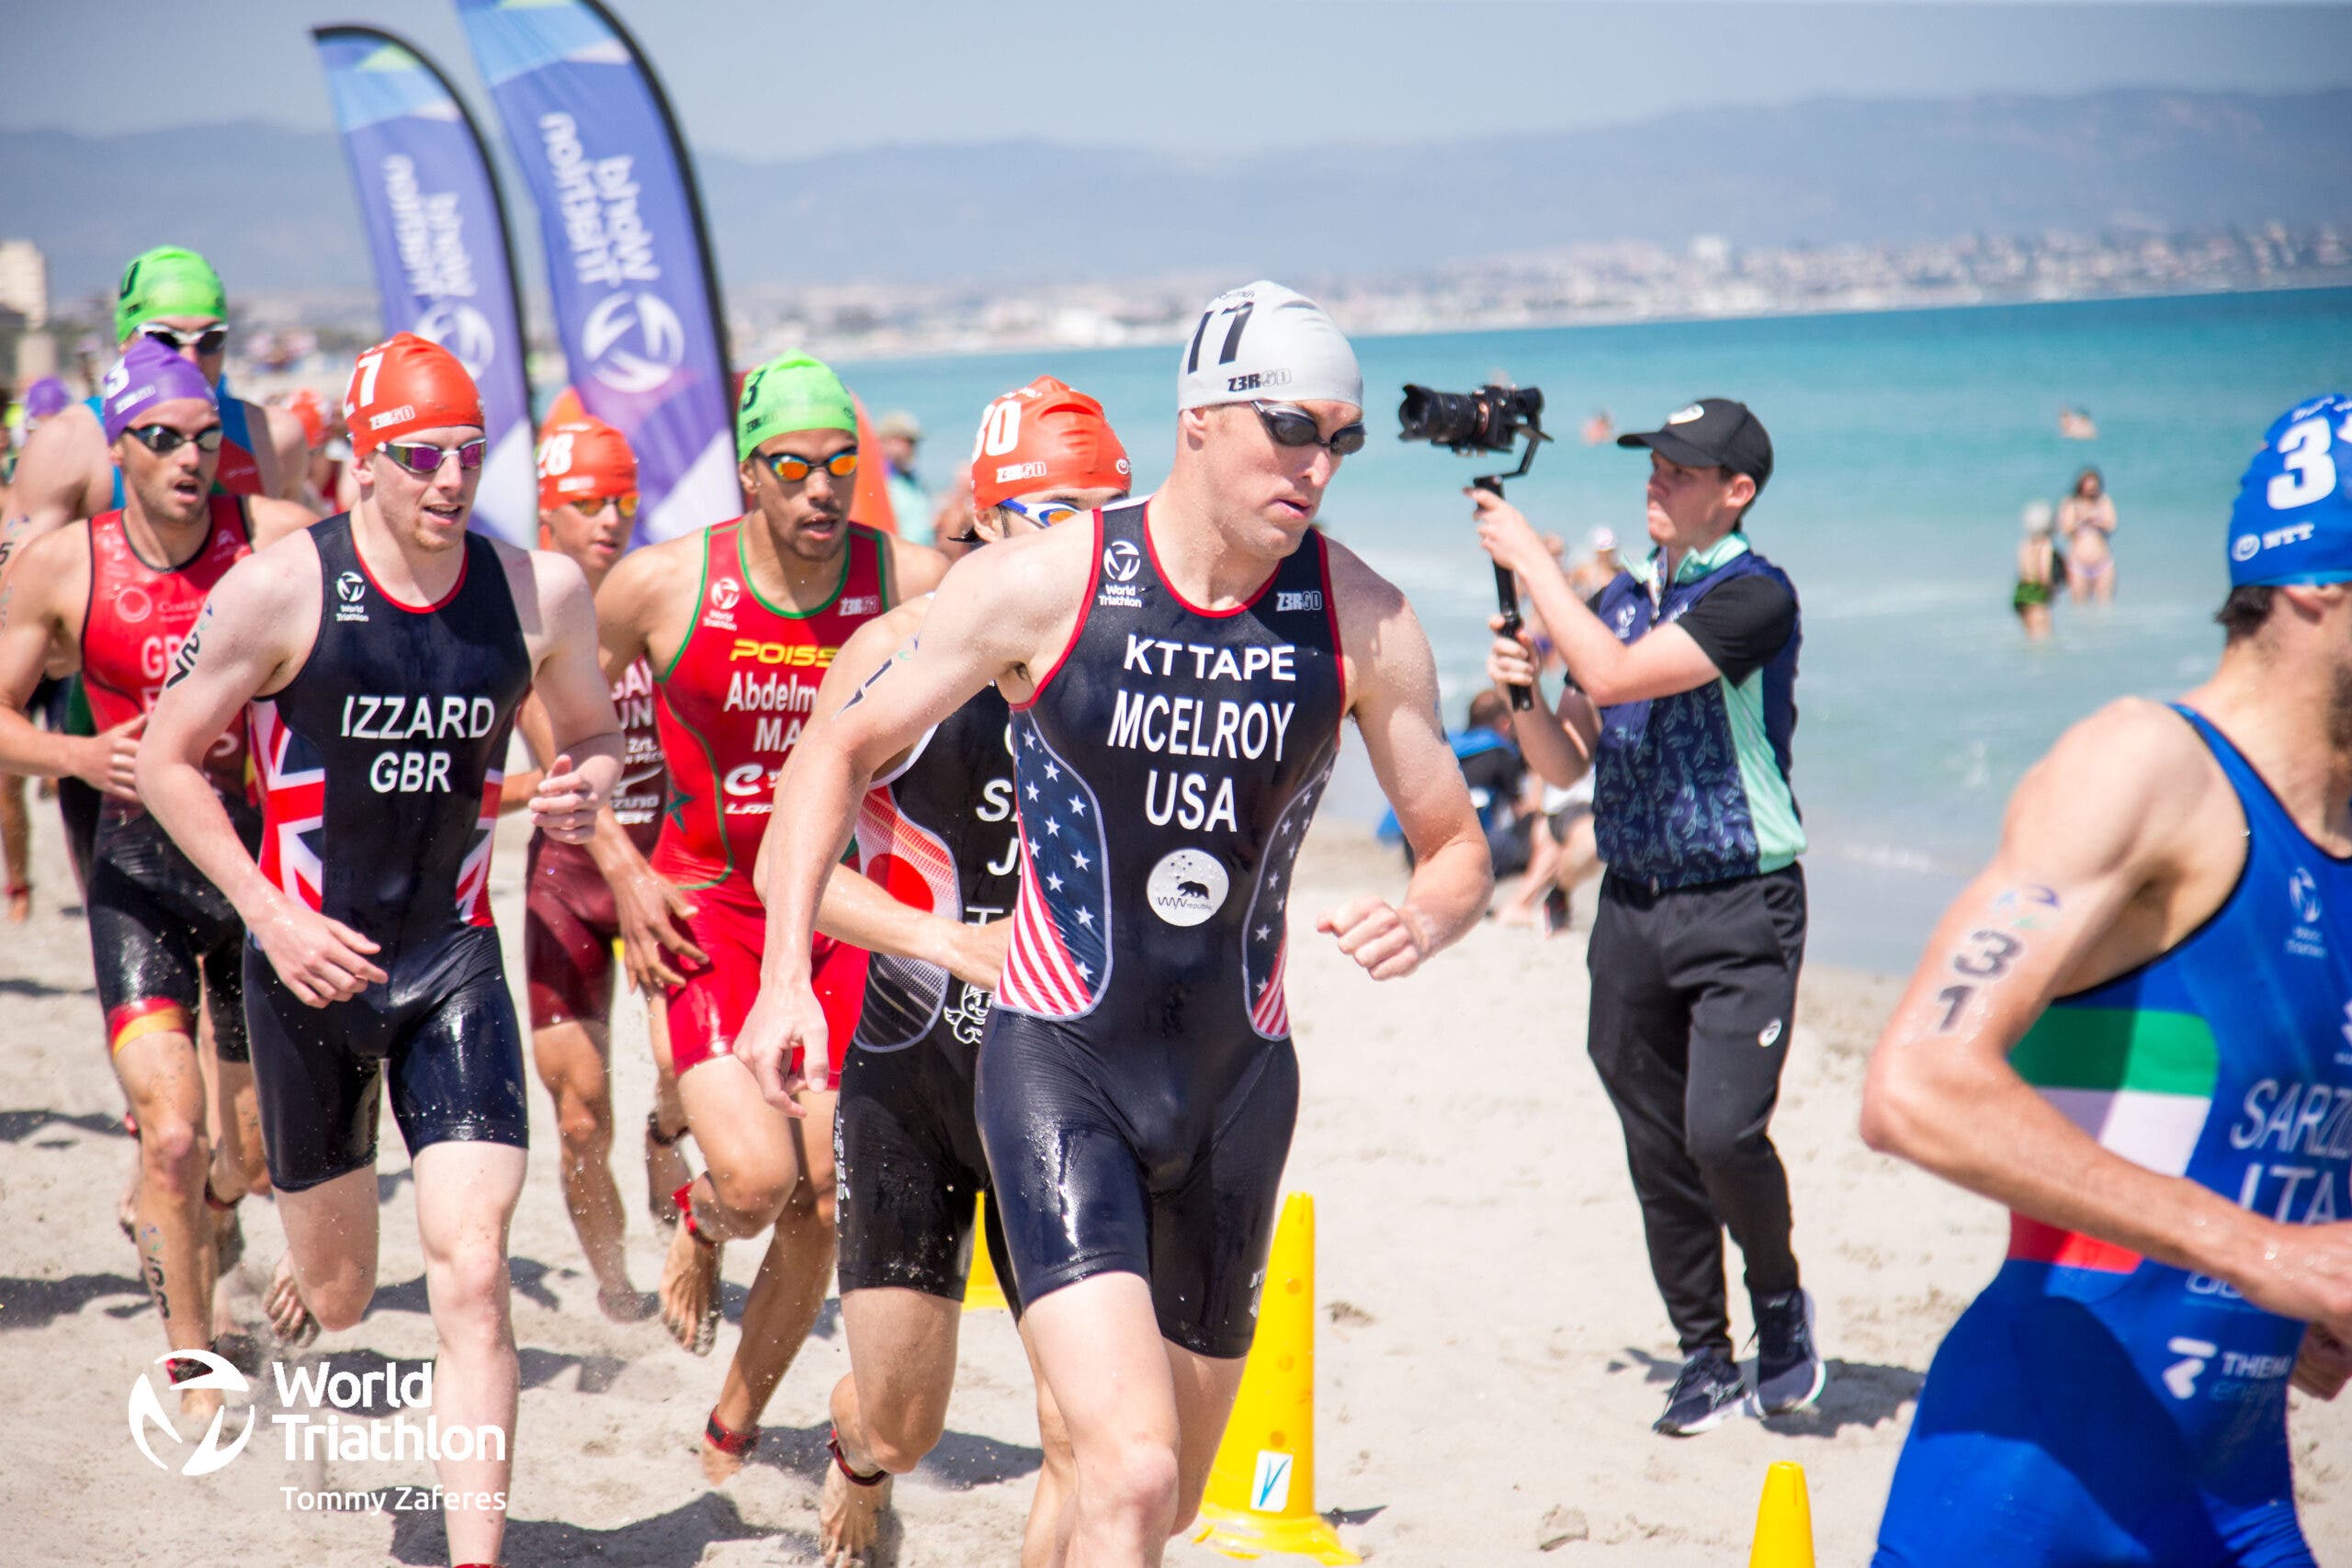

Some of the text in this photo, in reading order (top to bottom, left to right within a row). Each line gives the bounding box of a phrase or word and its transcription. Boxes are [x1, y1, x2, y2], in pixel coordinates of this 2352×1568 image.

[1188, 300, 1255, 376] 17
[340, 604, 365, 614] World
[1098, 595, 1142, 608] Triathlon
[1104, 584, 1136, 597] World
[336, 613, 369, 623] Triathlon
[1124, 633, 1297, 682] KT TAPE
[340, 694, 496, 740] IZZARD
[1106, 688, 1296, 762] MCELROY
[369, 750, 452, 794] GBR
[1145, 769, 1238, 833] USA
[2238, 1162, 2342, 1227] ITA
